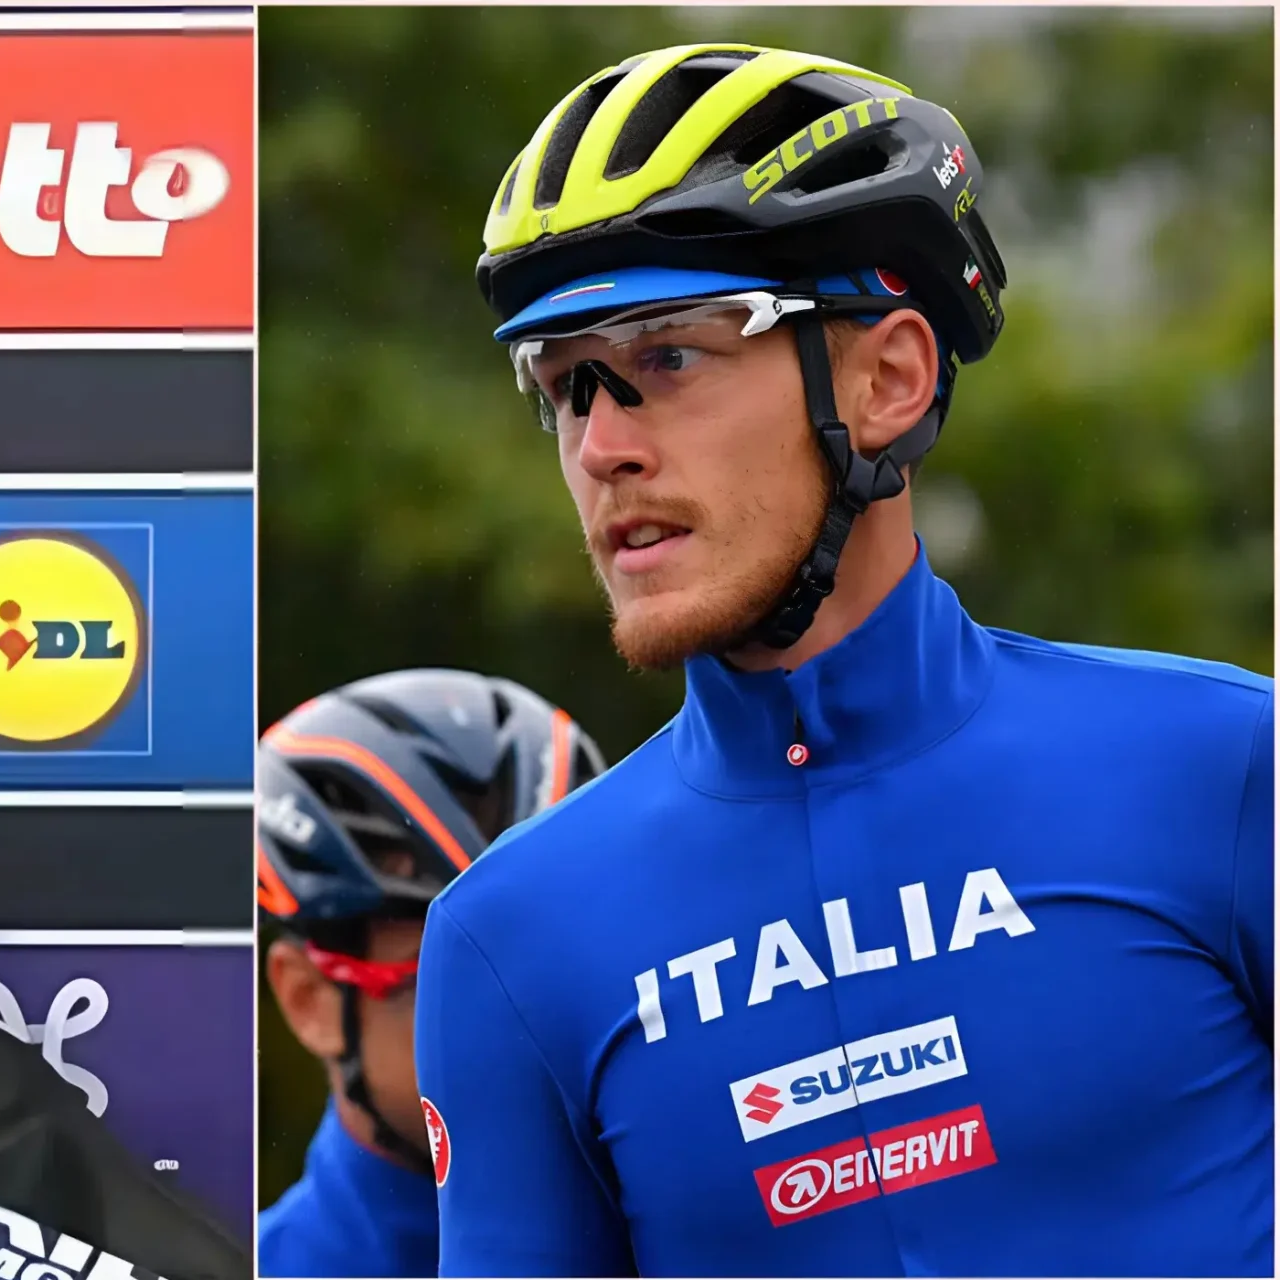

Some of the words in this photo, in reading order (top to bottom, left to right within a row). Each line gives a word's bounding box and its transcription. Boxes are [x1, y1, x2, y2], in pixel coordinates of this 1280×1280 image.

[742, 96, 901, 206] SCOTT
[634, 867, 1036, 1044] ITALIA
[789, 1034, 957, 1105] SUZUKI
